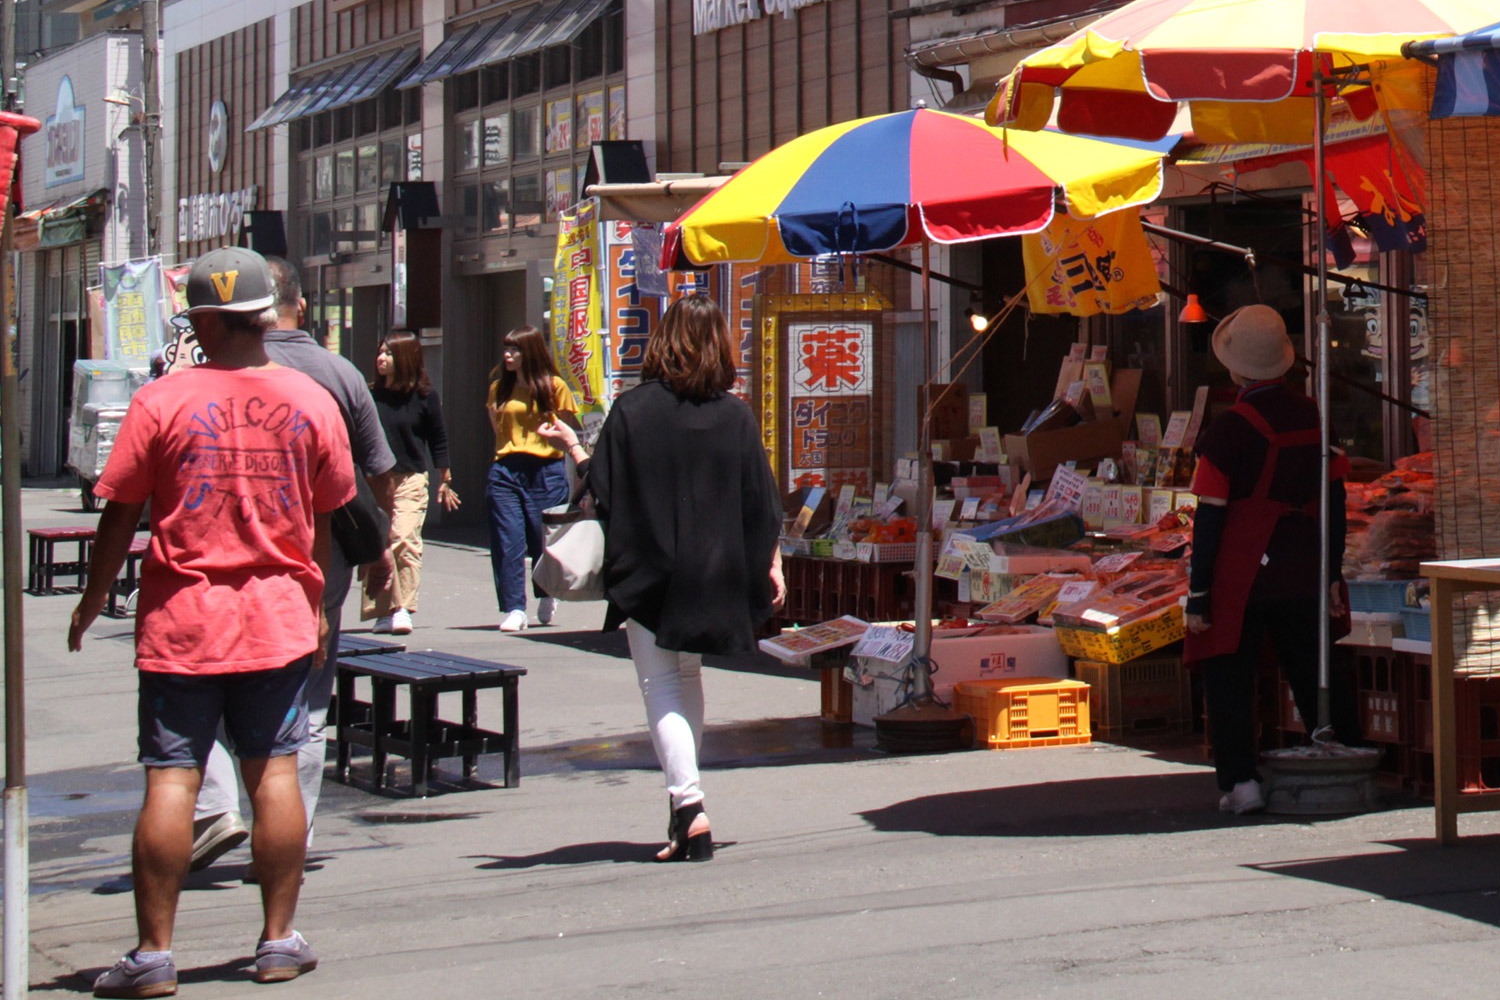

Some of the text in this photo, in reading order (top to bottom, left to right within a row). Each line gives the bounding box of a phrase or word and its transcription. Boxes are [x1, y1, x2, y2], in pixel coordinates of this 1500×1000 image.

[209, 269, 239, 303] V
[802, 330, 861, 388] 薬
[188, 396, 312, 446] VOLCOM
[795, 400, 867, 428] ダイコク
[802, 429, 857, 450] ドラッグ
[184, 482, 300, 525] STONE
